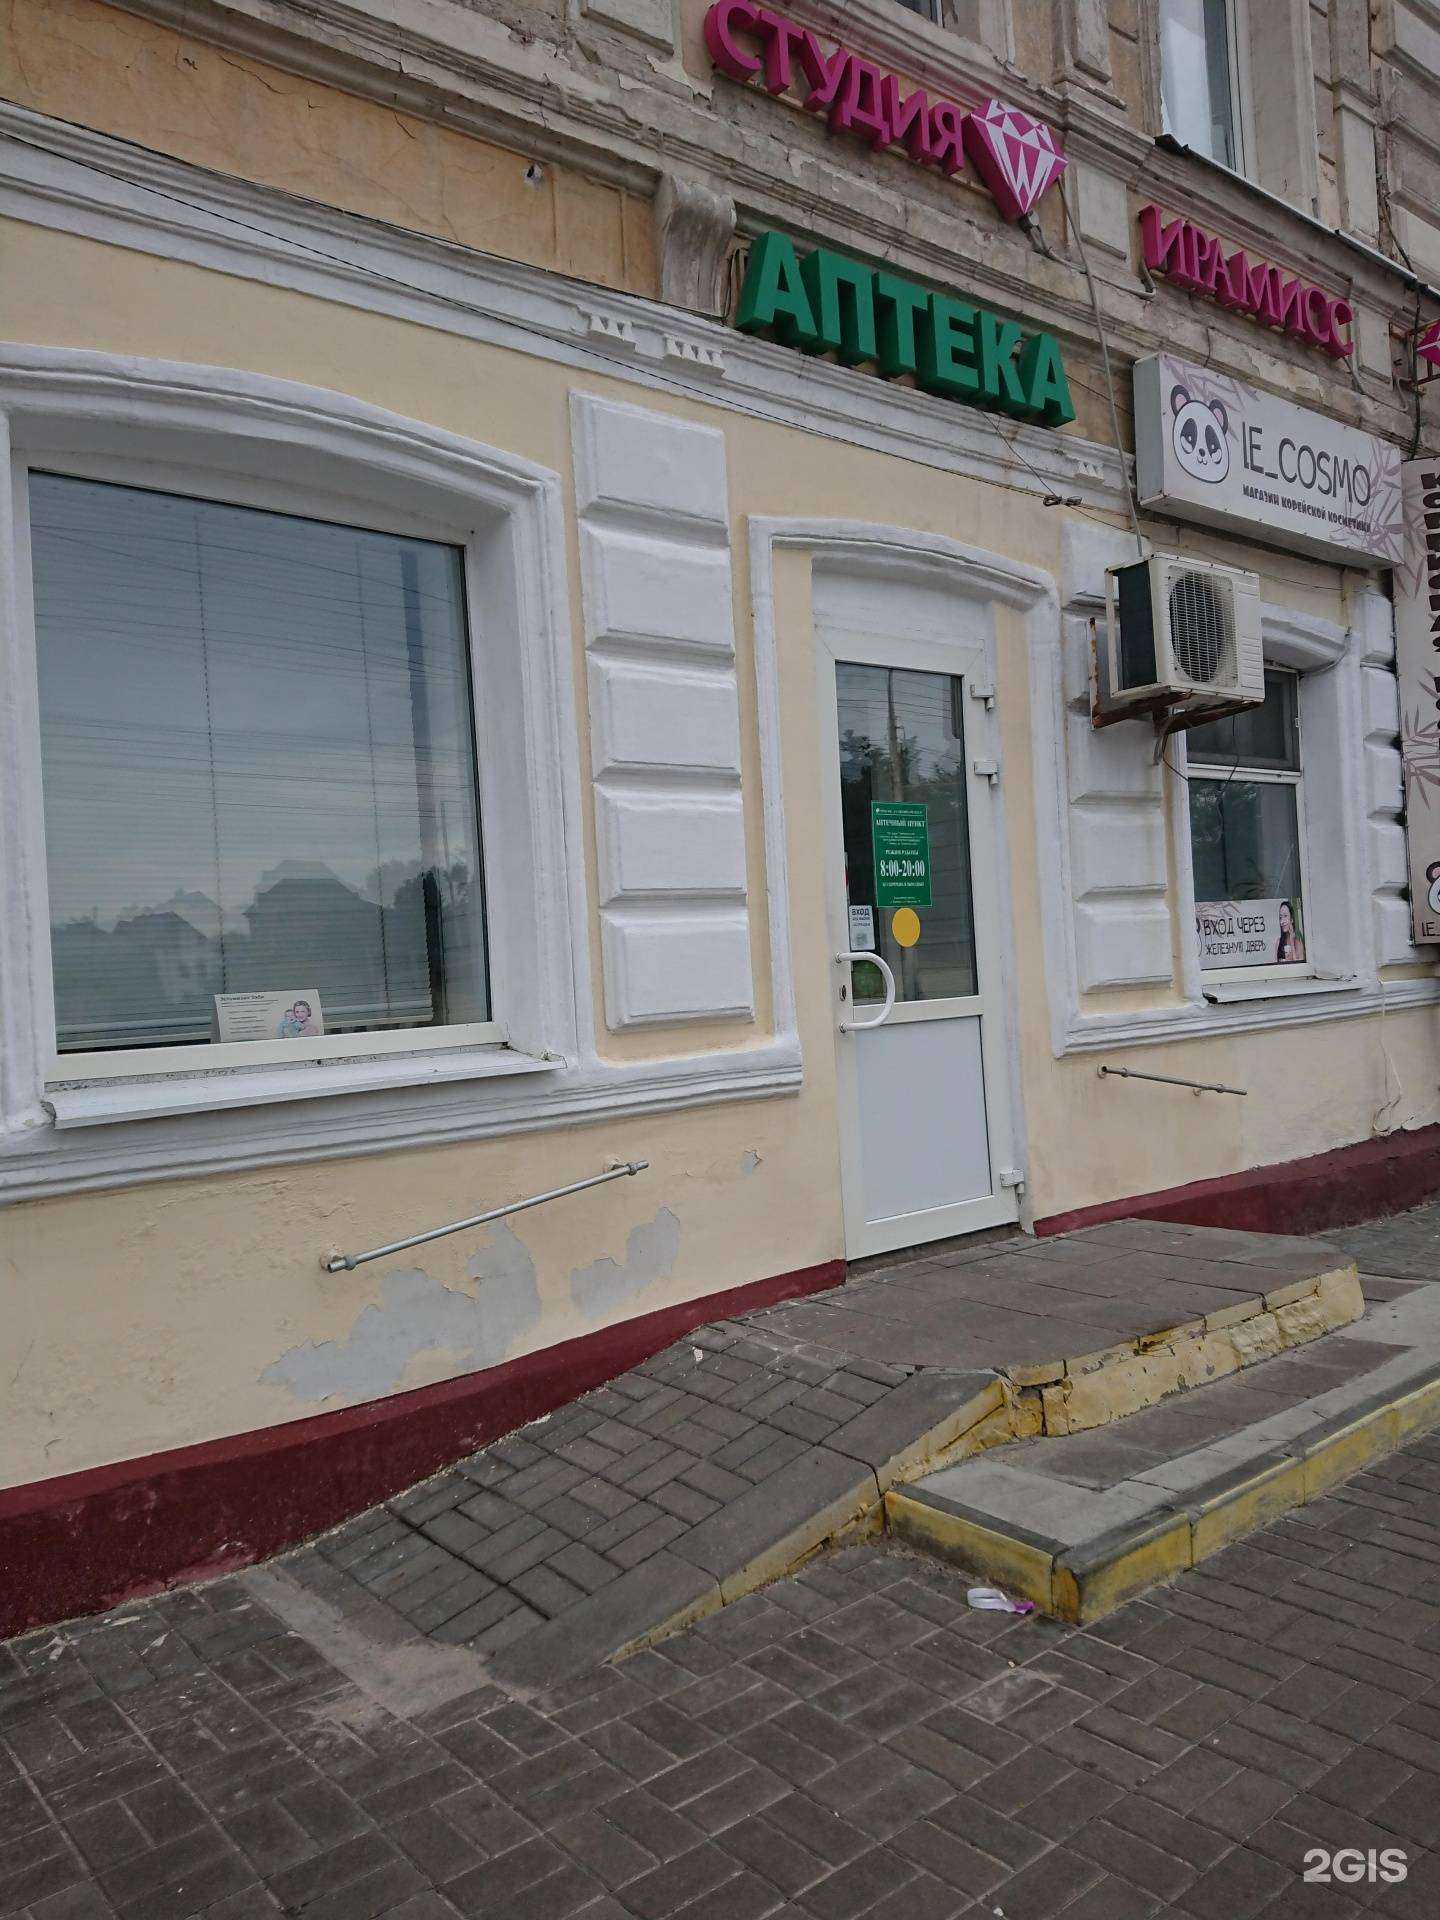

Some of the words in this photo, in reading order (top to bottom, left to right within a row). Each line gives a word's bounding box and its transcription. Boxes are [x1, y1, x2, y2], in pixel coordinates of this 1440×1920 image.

[704, 0, 964, 175] СТУДИЯ
[1139, 204, 1354, 359] ИРАМИСС
[736, 231, 1076, 428] АПТЕКА
[1243, 483, 1280, 506] МАГАЗИН
[1281, 495, 1327, 520] КОРЕЙСКОЙ
[880, 859, 925, 877] 8:00-20:00
[1203, 917, 1235, 937] ВХОД
[1236, 916, 1266, 934] ЧЕРЕЗ
[1245, 939, 1267, 954] ДВЕРЬ
